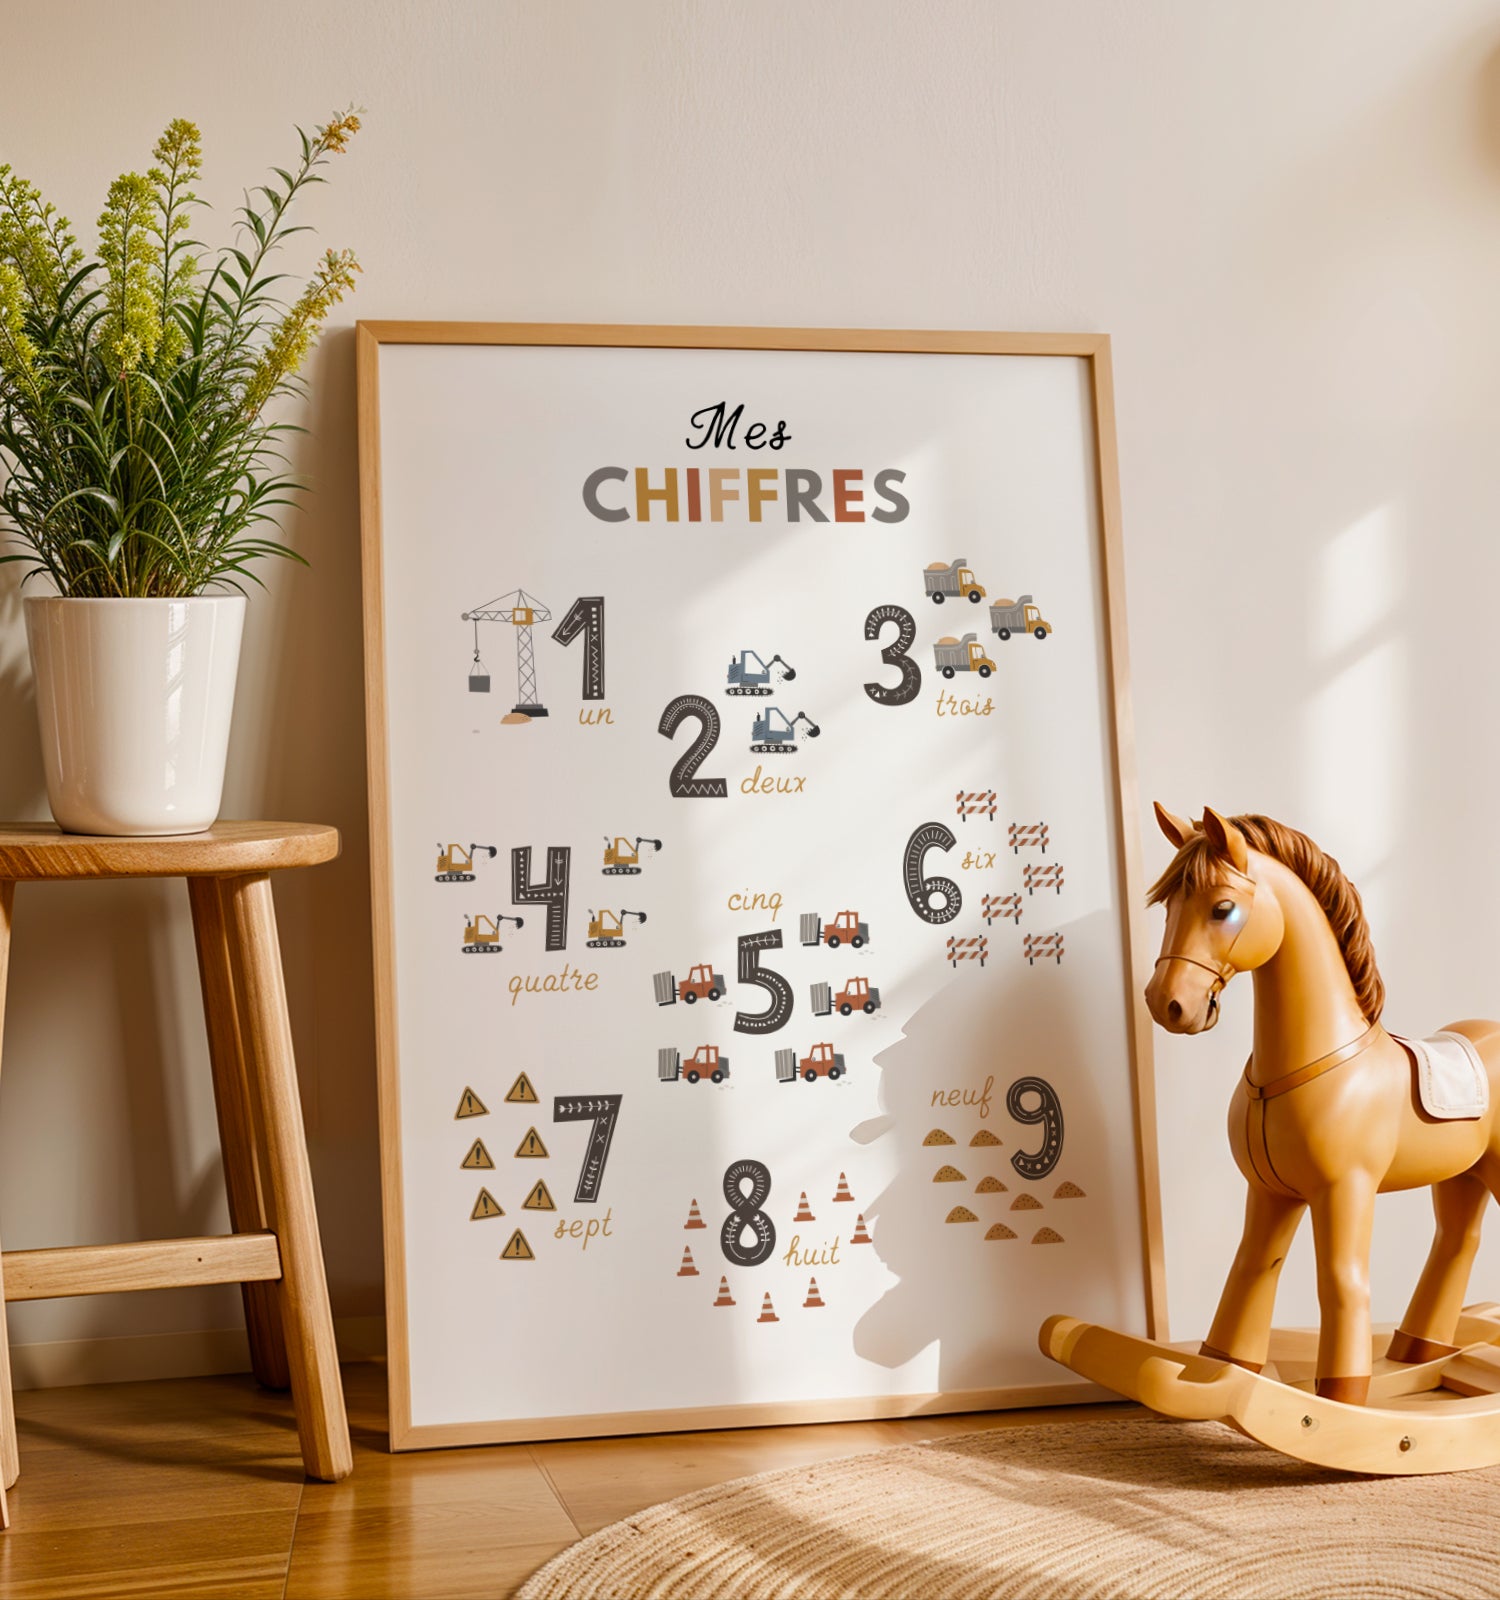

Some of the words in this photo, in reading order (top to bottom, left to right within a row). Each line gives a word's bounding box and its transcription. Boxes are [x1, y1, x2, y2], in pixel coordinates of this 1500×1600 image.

[685, 400, 793, 451] Mes
[582, 466, 910, 524] CHIFFRES
[551, 596, 605, 700] 1
[863, 604, 921, 706] 3
[578, 707, 614, 726] un
[936, 689, 996, 717] trois
[657, 694, 728, 798] 2
[740, 764, 807, 795] deux
[903, 822, 961, 925] 6
[961, 848, 997, 871] six
[511, 846, 571, 951] 4
[727, 888, 784, 922] cinq
[508, 964, 599, 1006] quatre
[733, 929, 794, 1035] 5
[931, 1075, 994, 1119] neuf
[553, 1094, 623, 1203] 7
[1006, 1076, 1064, 1180] 9
[554, 1207, 613, 1250] sept
[720, 1159, 776, 1267] 8
[782, 1234, 841, 1267] huit
